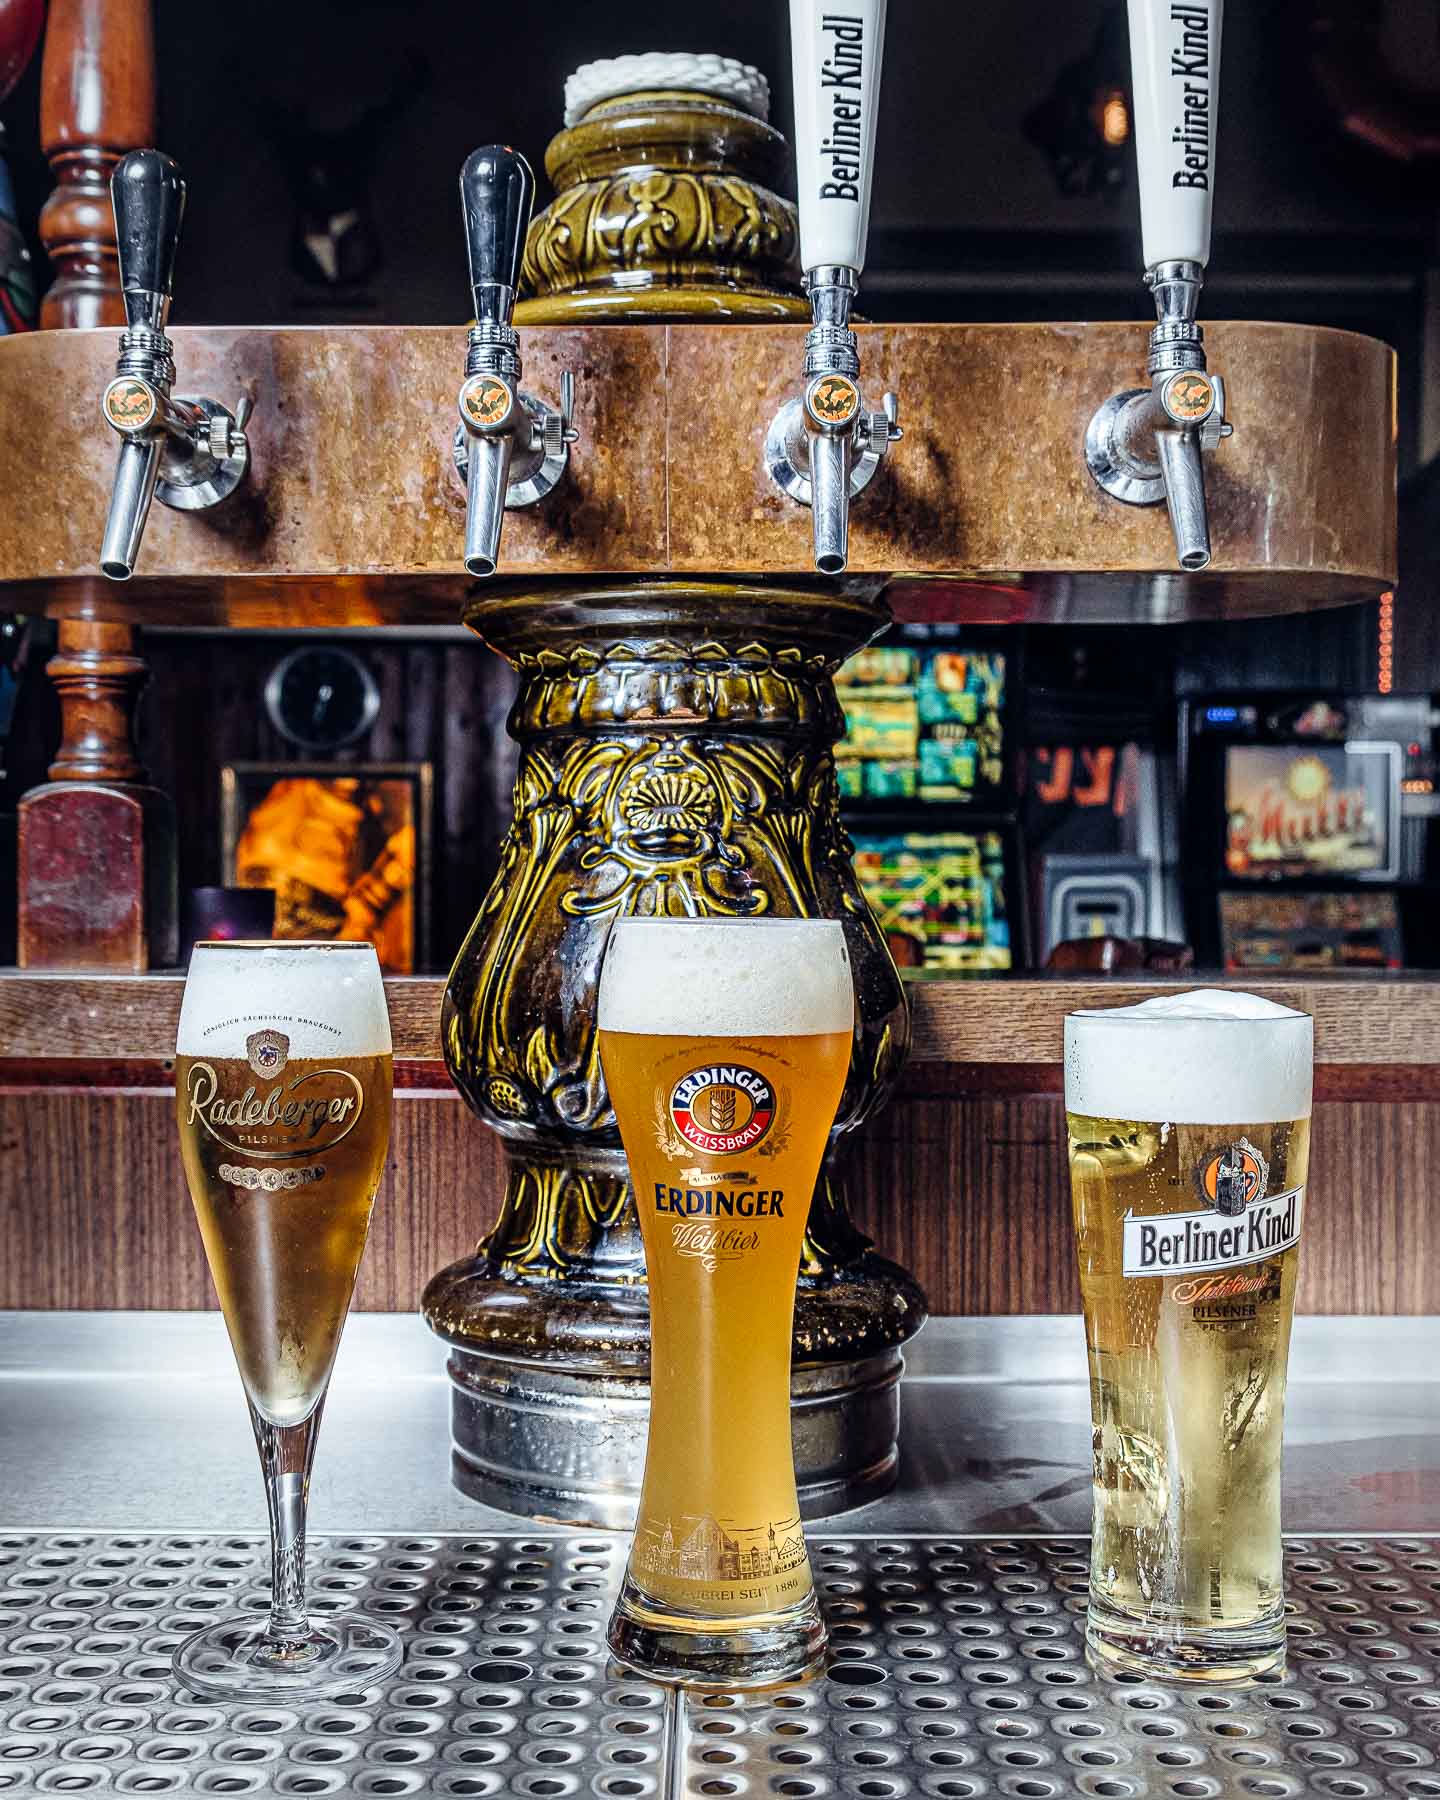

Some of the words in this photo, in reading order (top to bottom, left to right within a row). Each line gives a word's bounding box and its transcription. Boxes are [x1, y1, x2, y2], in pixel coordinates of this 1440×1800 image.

[821, 15, 864, 90] Kindl
[1170, 3, 1209, 80] Kindl
[819, 93, 862, 203] Berliner
[1172, 82, 1209, 192] Berliner
[297, 1017, 342, 1037] BRAUKUNST
[186, 1061, 355, 1138] Radeberger
[674, 1067, 770, 1105] ERDINGER
[683, 1122, 762, 1150] WEISSBRÄU
[654, 1183, 785, 1218] ERDINGER
[671, 1223, 761, 1257] Weißbier
[1139, 1220, 1245, 1267] Berliner
[1246, 1194, 1297, 1253] Kindl
[1191, 1303, 1257, 1318] PILSENER
